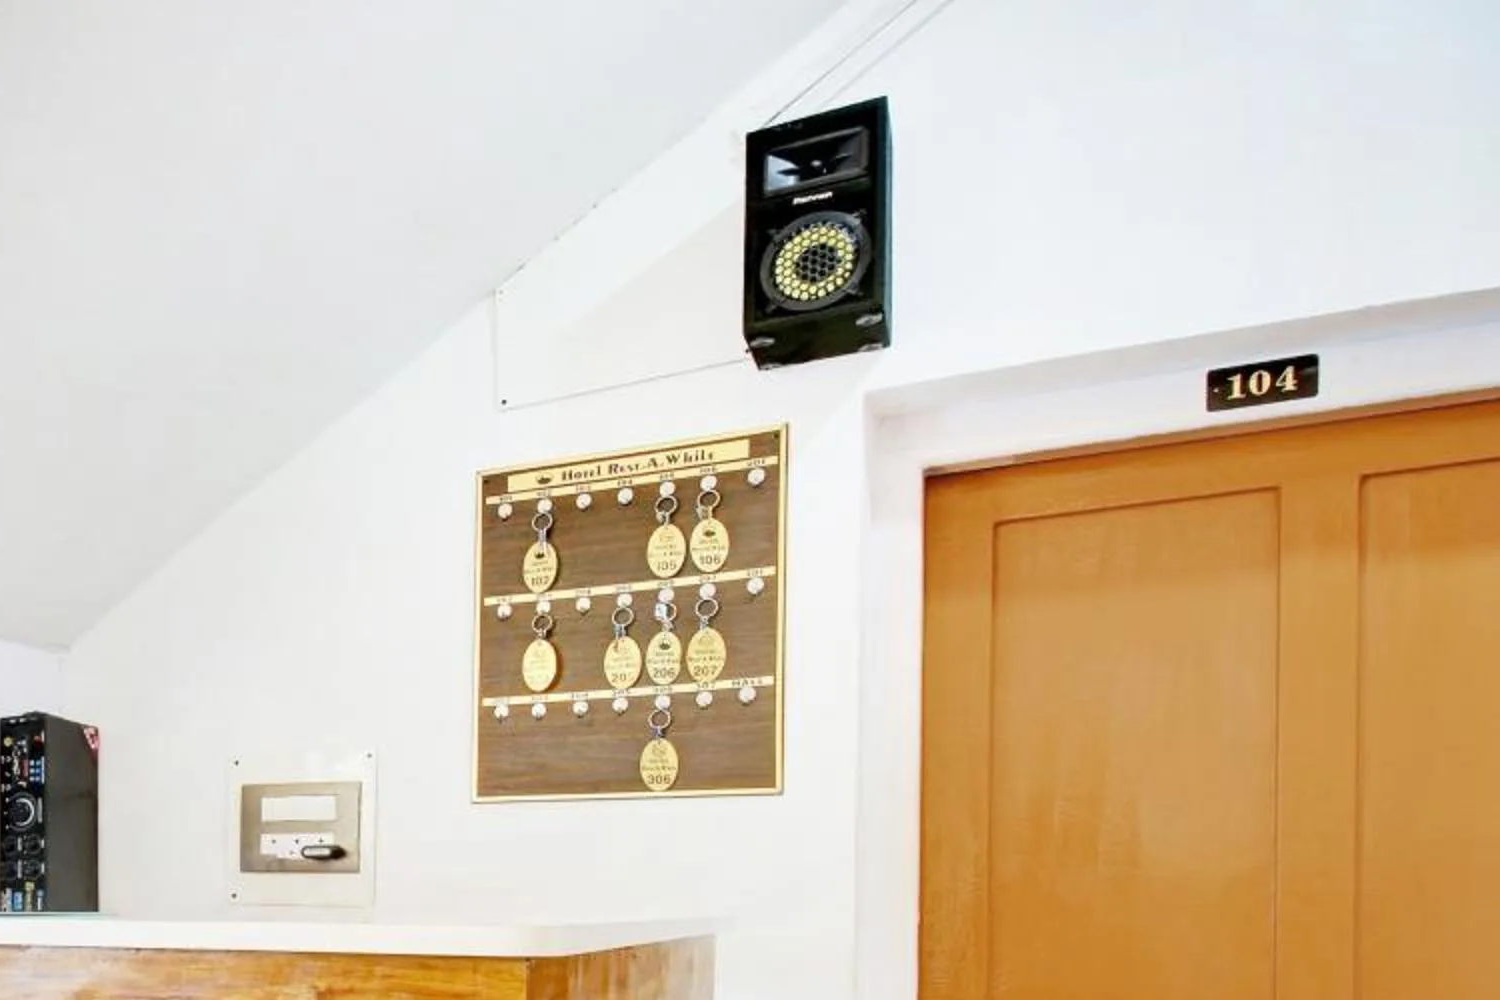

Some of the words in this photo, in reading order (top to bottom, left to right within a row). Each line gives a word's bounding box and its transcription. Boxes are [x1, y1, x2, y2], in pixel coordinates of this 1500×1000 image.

[1226, 365, 1299, 401] 104
[653, 667, 675, 679] 206
[693, 664, 718, 677] 207
[647, 774, 672, 785] 306
